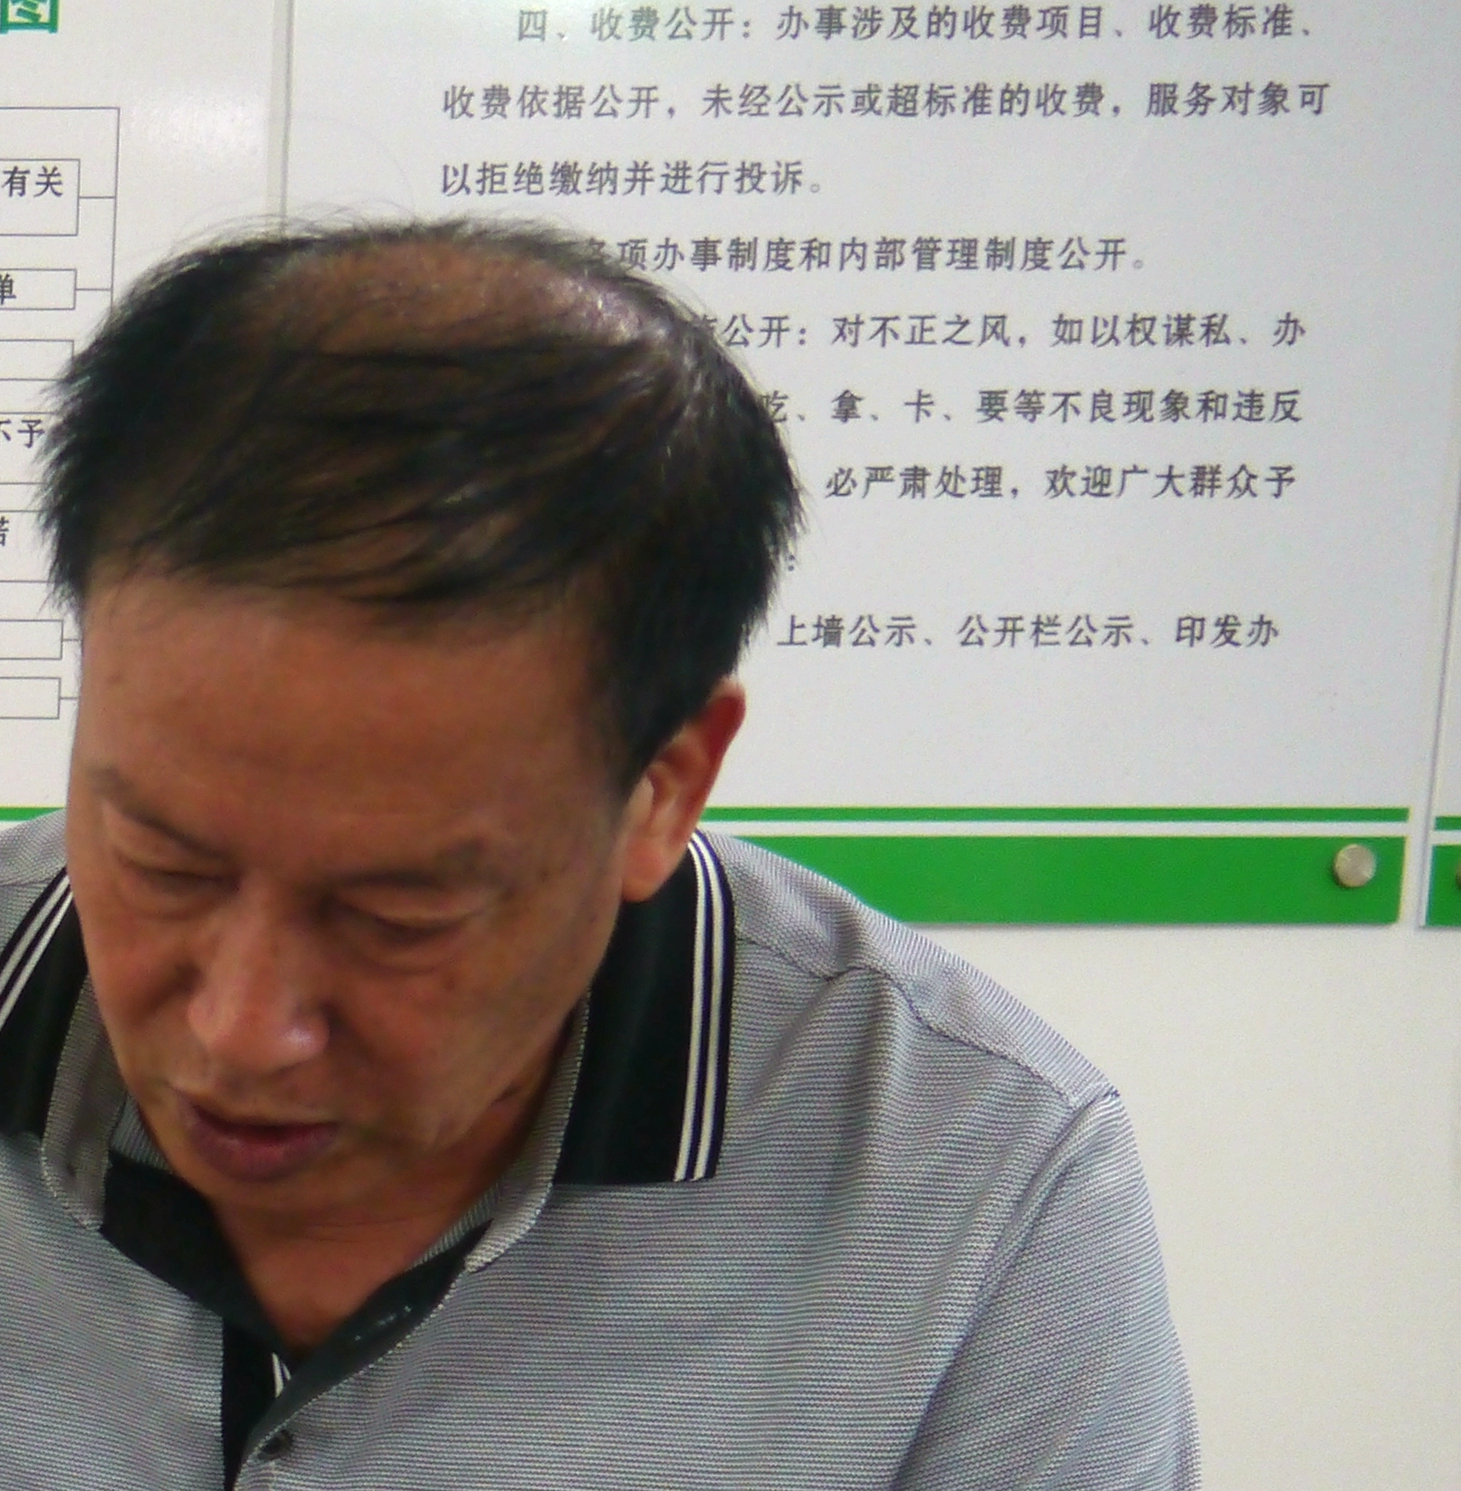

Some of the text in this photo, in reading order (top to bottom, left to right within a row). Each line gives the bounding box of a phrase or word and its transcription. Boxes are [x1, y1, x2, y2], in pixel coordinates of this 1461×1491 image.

[442, 160, 826, 198] 以拒绝缴纳并进行投诉。
